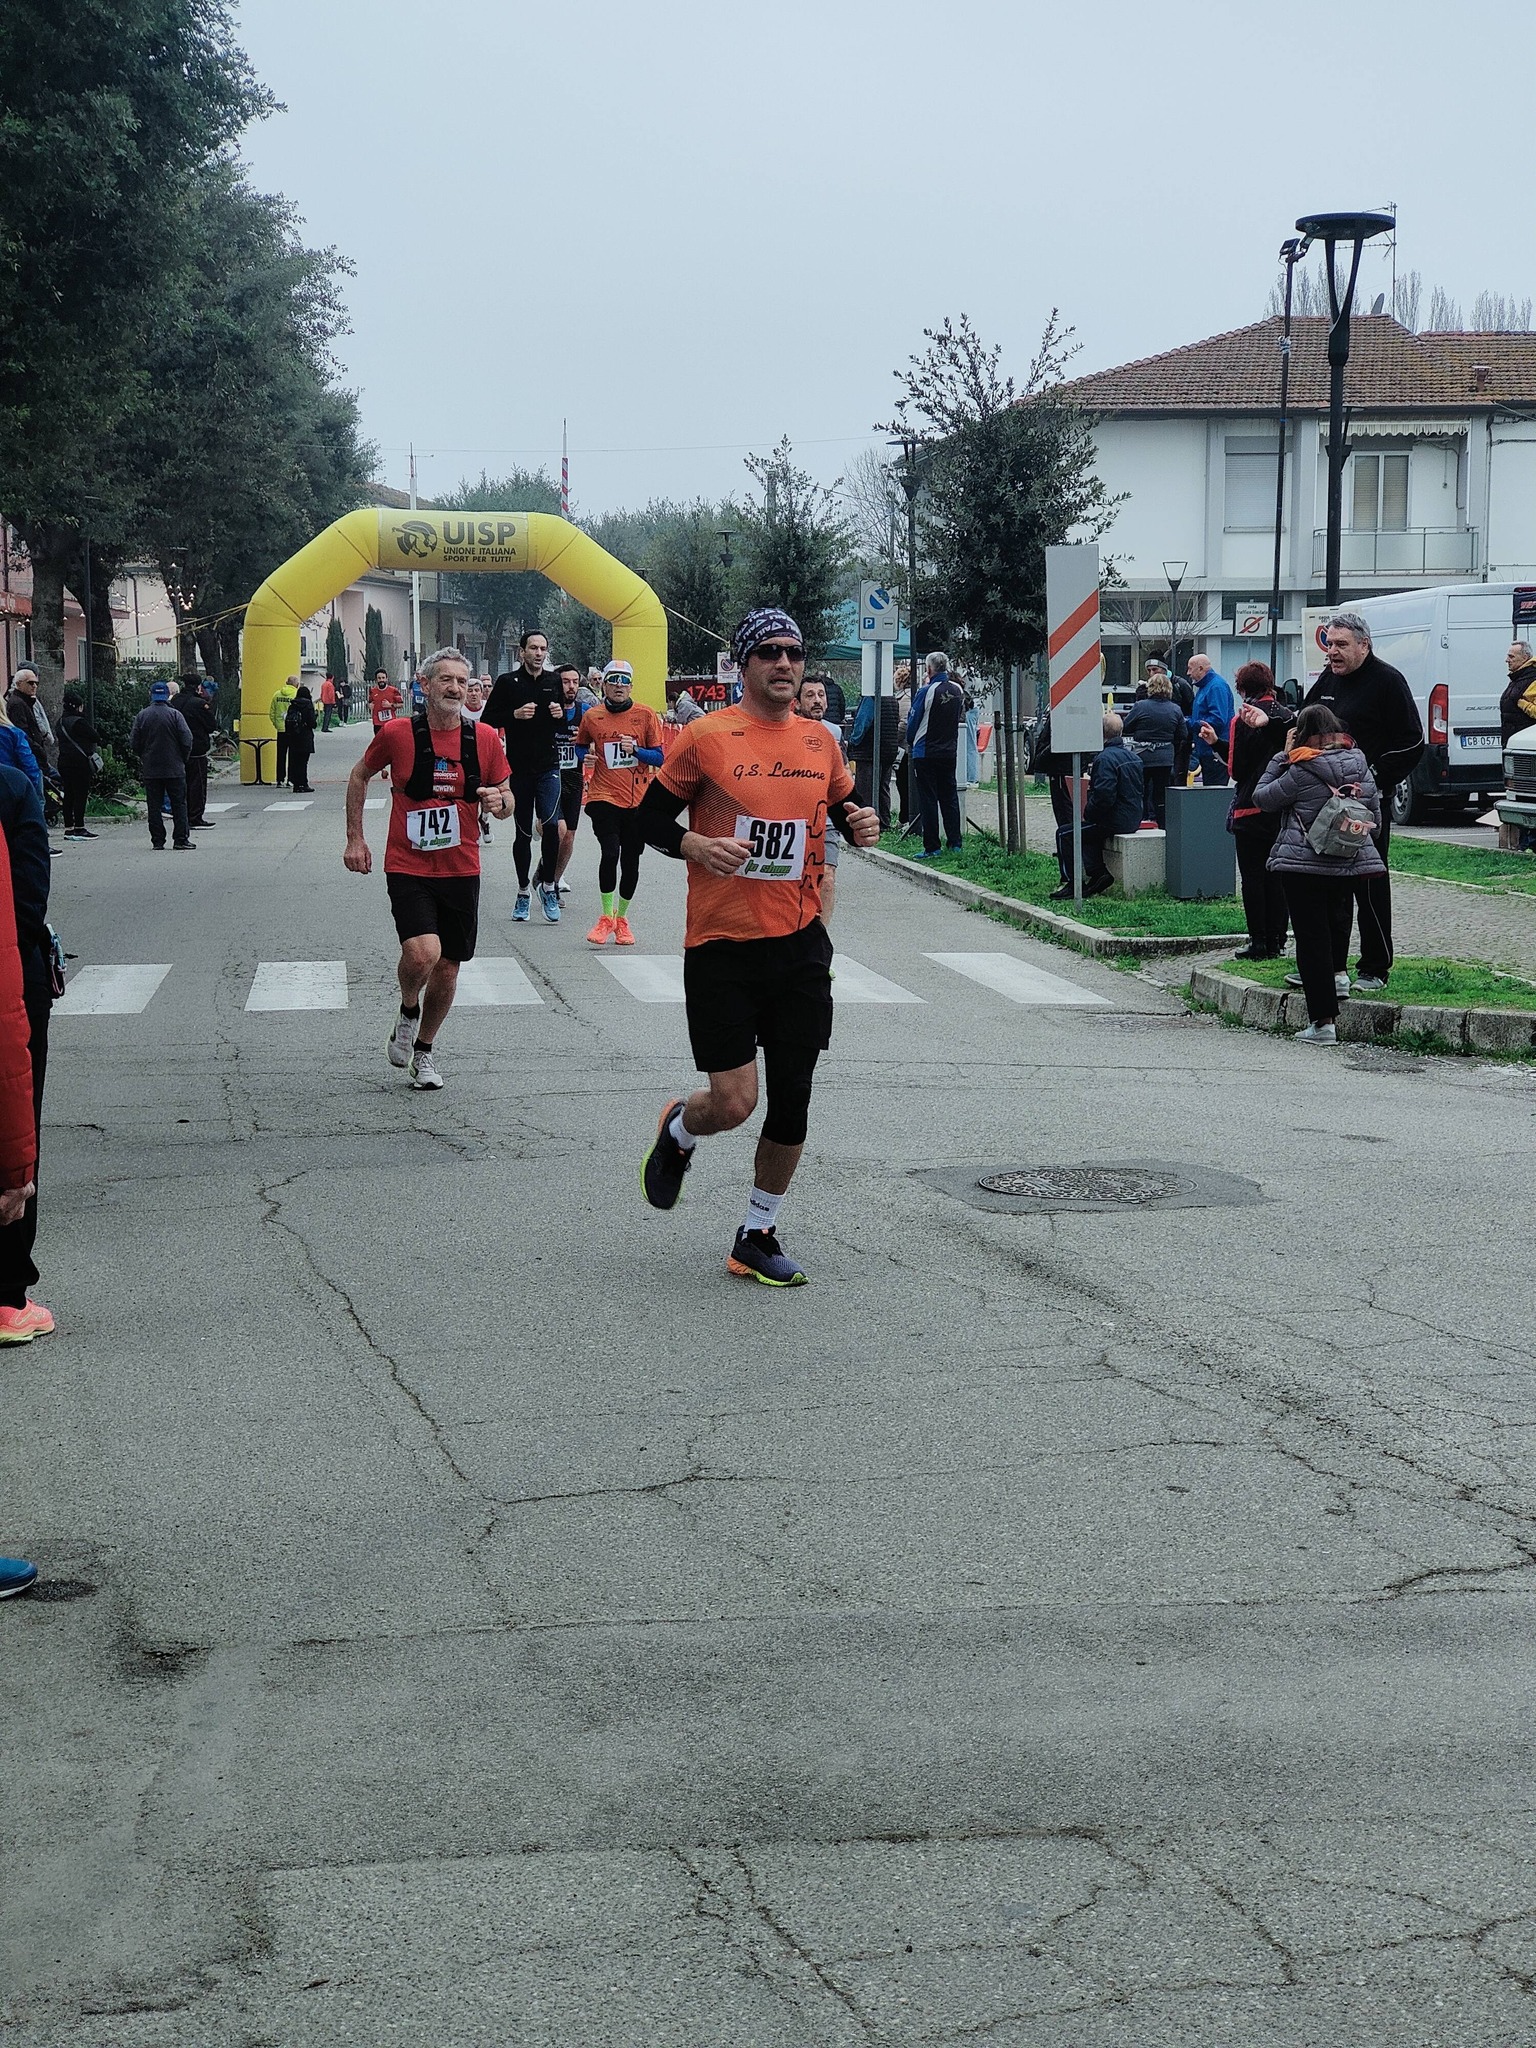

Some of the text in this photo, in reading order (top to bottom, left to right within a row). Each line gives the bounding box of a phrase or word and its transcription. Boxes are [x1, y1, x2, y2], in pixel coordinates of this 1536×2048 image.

[443, 521, 516, 546] UISP
[443, 546, 517, 555] UNIONE ITALIANA
[443, 555, 512, 563] SPORT PER TUTTI
[865, 618, 873, 628] P
[1467, 736, 1478, 746] GB
[612, 743, 632, 760] 75
[733, 761, 825, 780] G.S. Lamone
[418, 808, 452, 837] 742
[748, 820, 796, 860] 682
